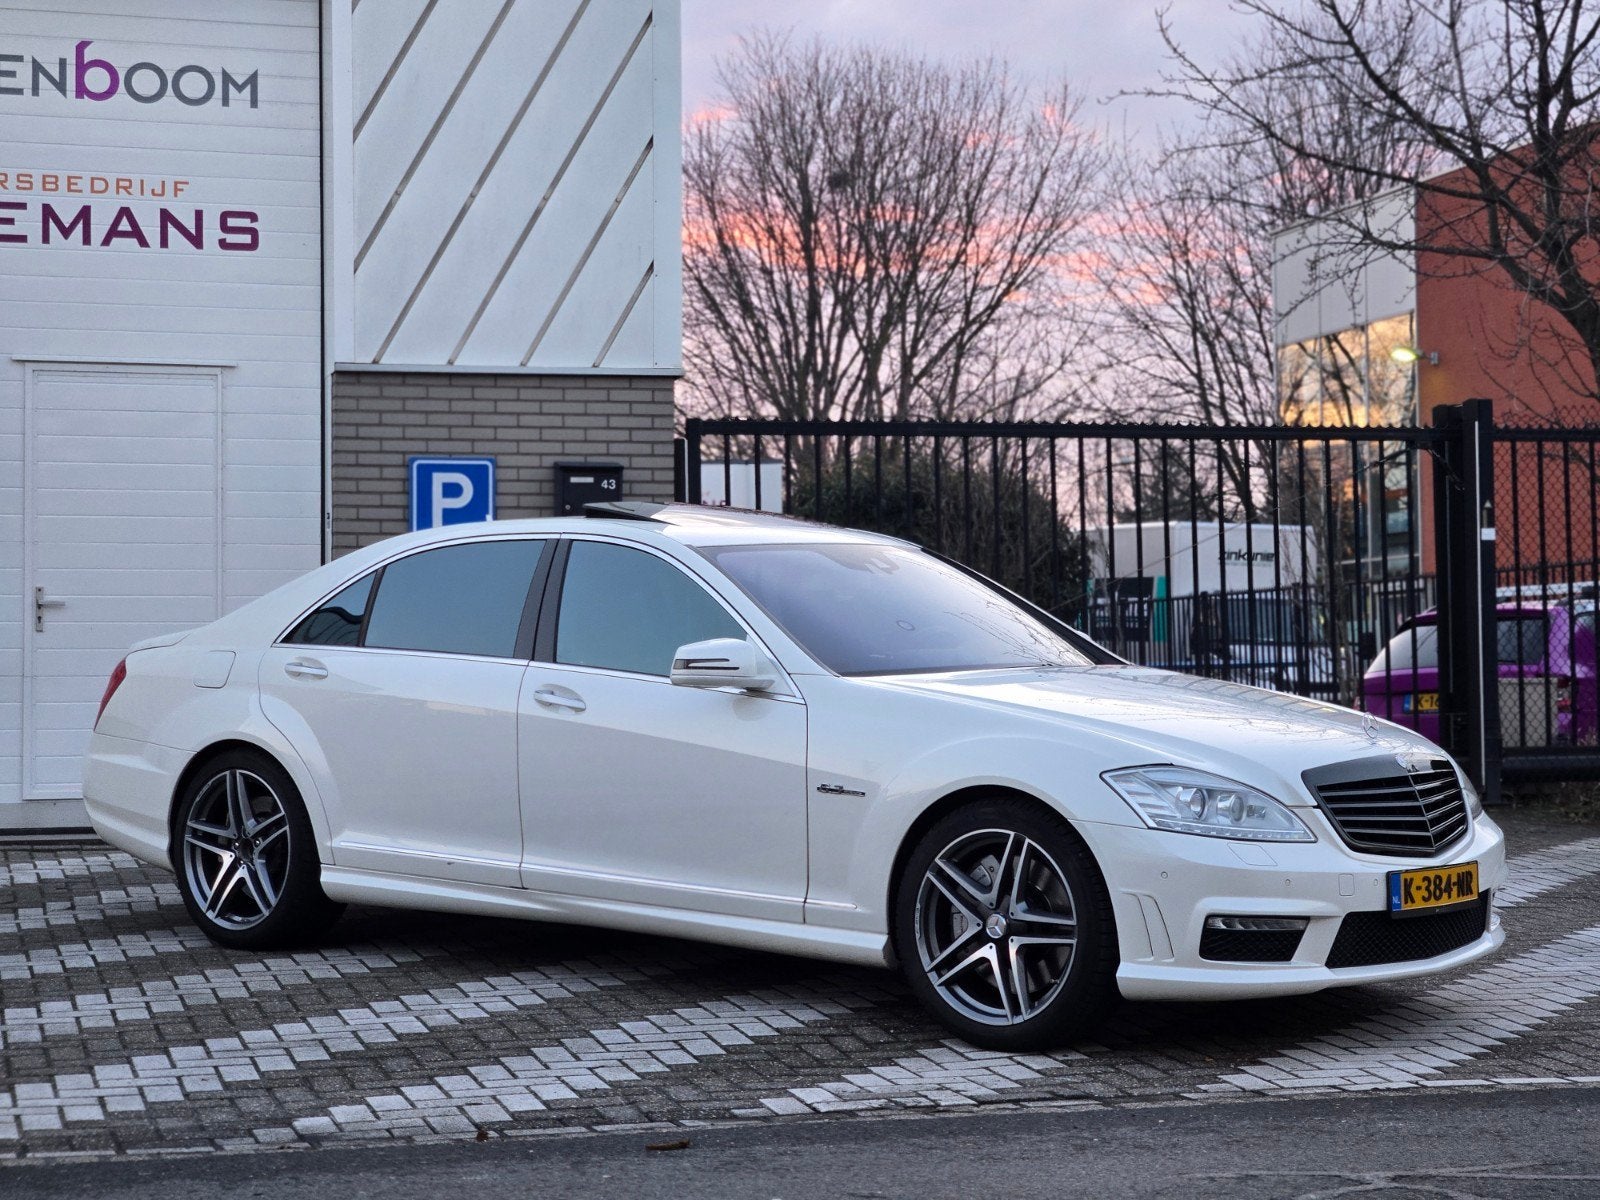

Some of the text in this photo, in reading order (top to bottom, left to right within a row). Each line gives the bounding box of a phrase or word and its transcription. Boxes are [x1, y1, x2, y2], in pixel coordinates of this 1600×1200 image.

[0, 173, 190, 198] RSBEDRIJF
[0, 202, 260, 252] EMANS
[601, 479, 616, 490] 43
[432, 472, 474, 528] P
[1392, 896, 1400, 904] NL
[1404, 870, 1473, 904] K-384-NR
